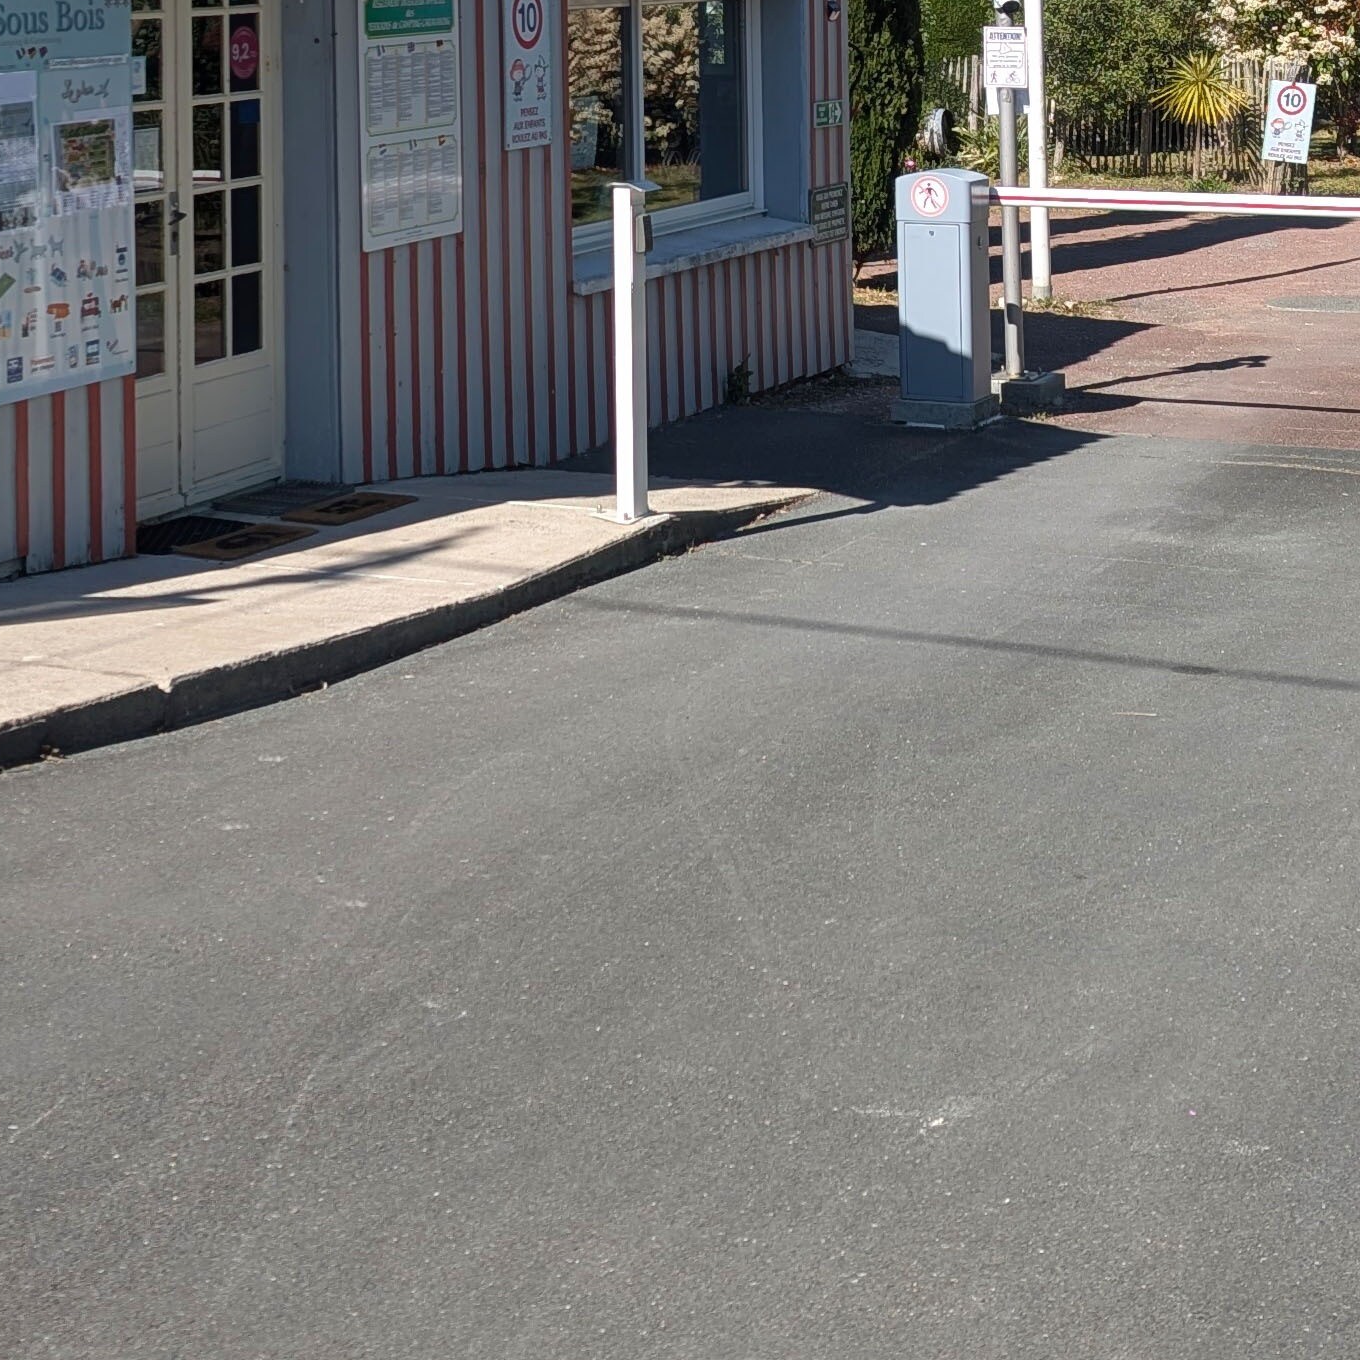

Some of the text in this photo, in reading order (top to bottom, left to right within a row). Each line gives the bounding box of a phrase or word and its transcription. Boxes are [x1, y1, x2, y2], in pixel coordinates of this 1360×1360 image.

[55, 0, 105, 33] Bois
[518, 2, 537, 33] 10
[1283, 93, 1301, 107] 10
